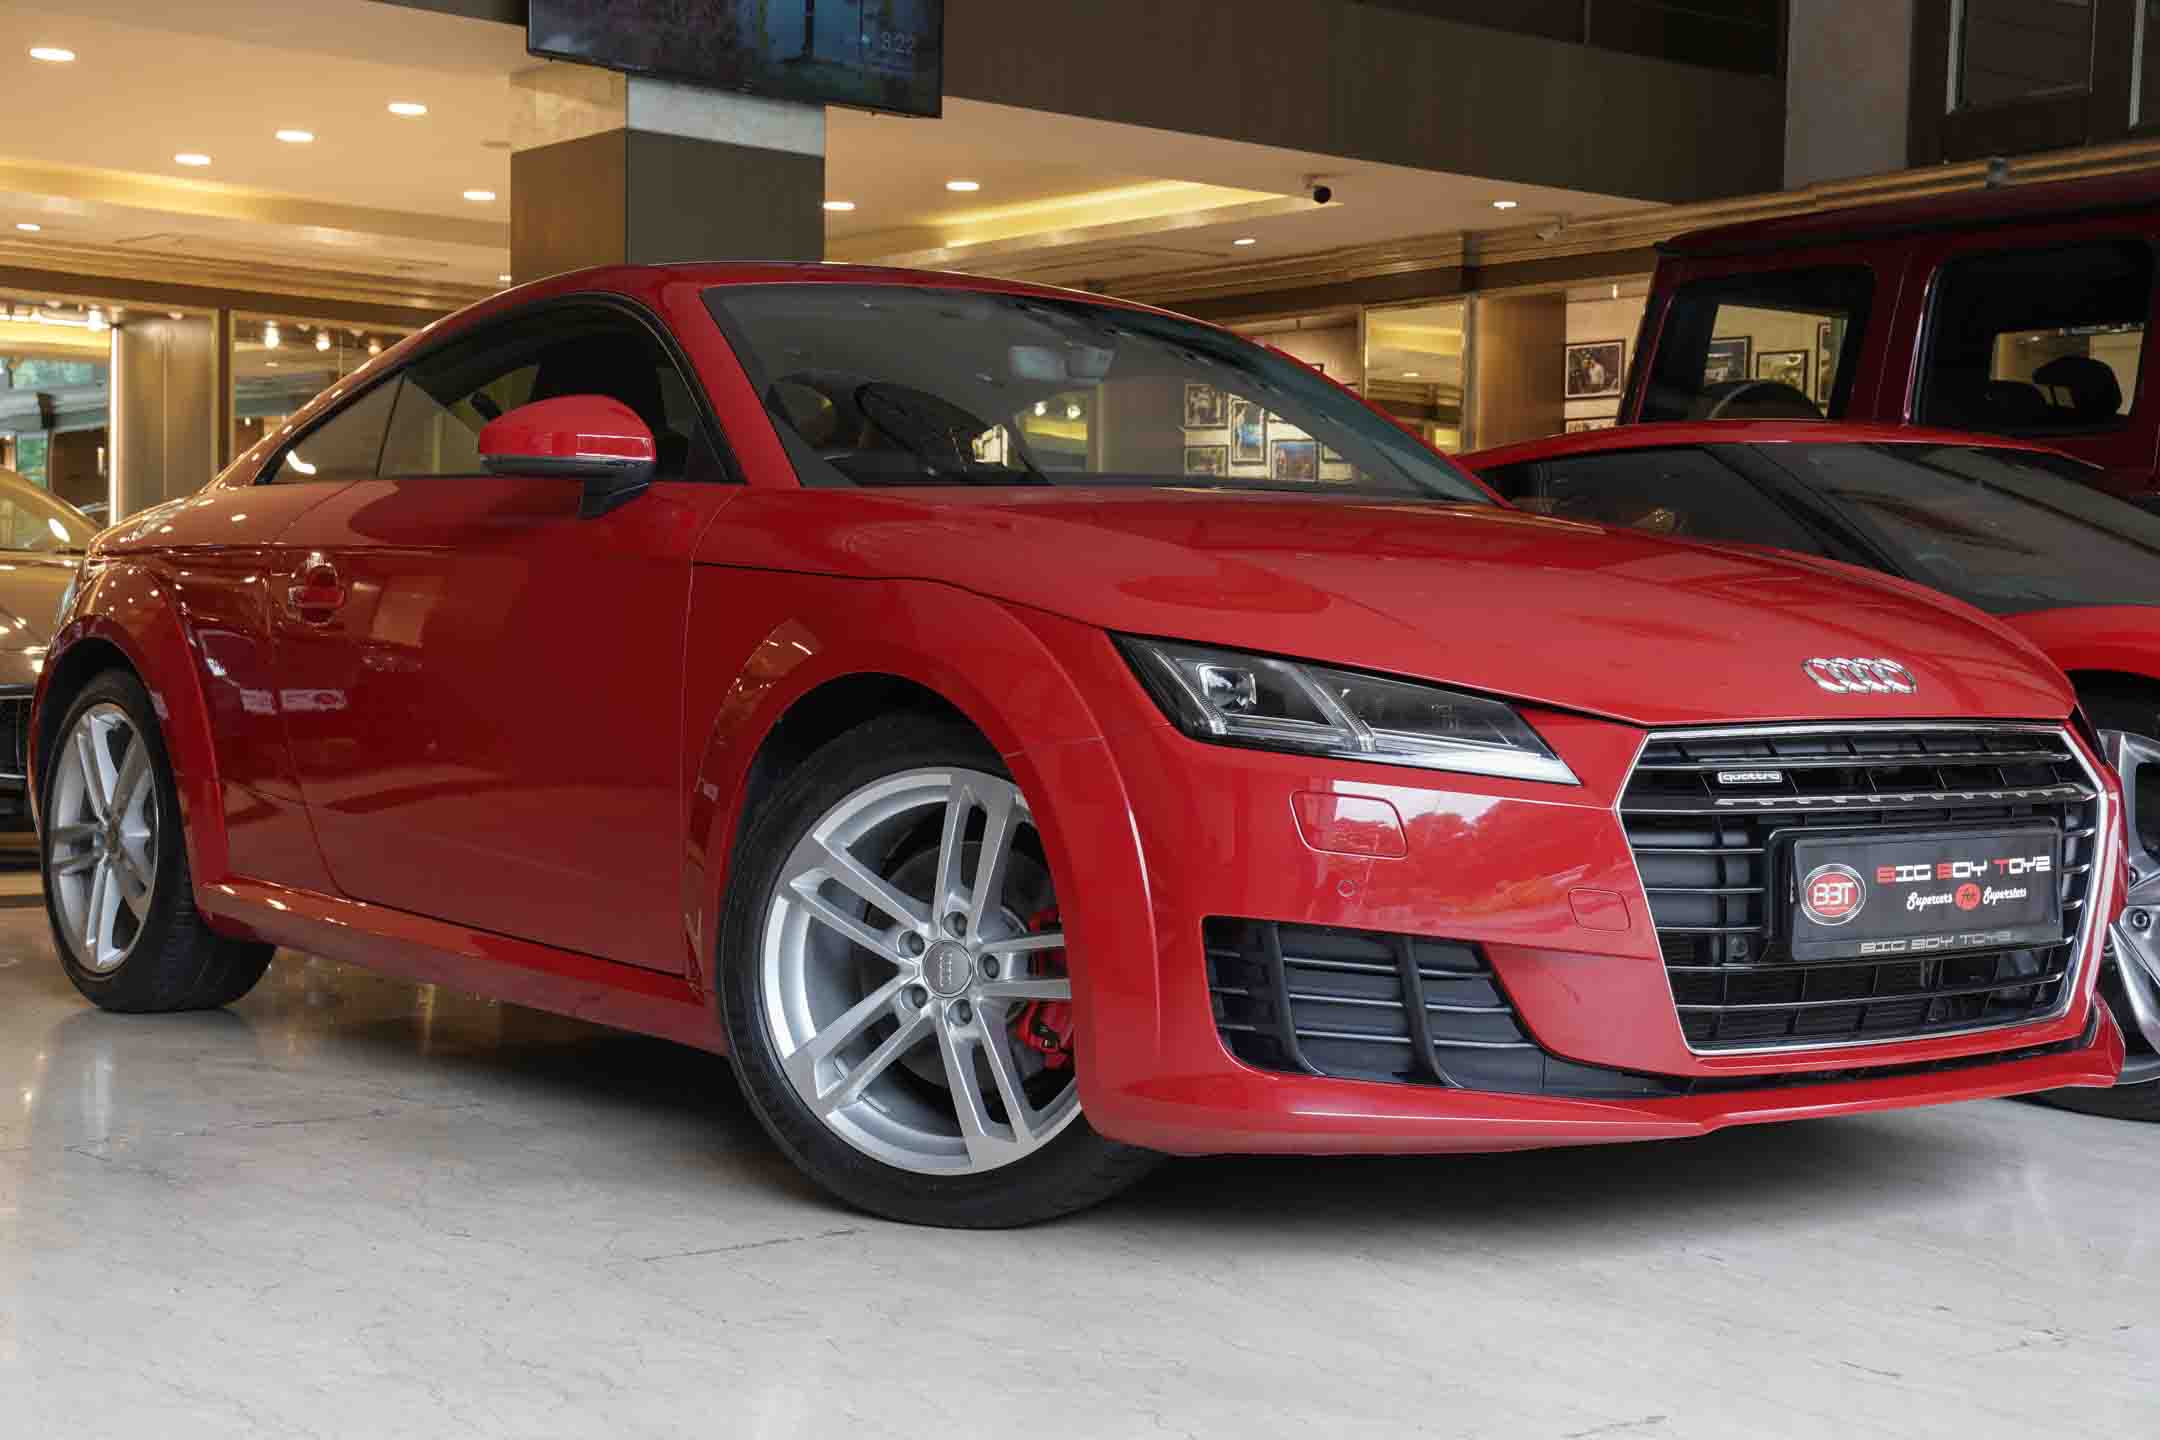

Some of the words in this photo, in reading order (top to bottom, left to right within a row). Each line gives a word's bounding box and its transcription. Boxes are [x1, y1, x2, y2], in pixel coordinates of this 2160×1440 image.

[1722, 772, 1780, 783] quattro
[1876, 864, 1932, 885] BIG
[1936, 859, 1989, 880] BOY
[1992, 855, 2051, 876] TOYZ
[1813, 881, 1855, 906] BBT
[1860, 940, 1906, 954] BIG
[1911, 936, 1955, 950] BOY
